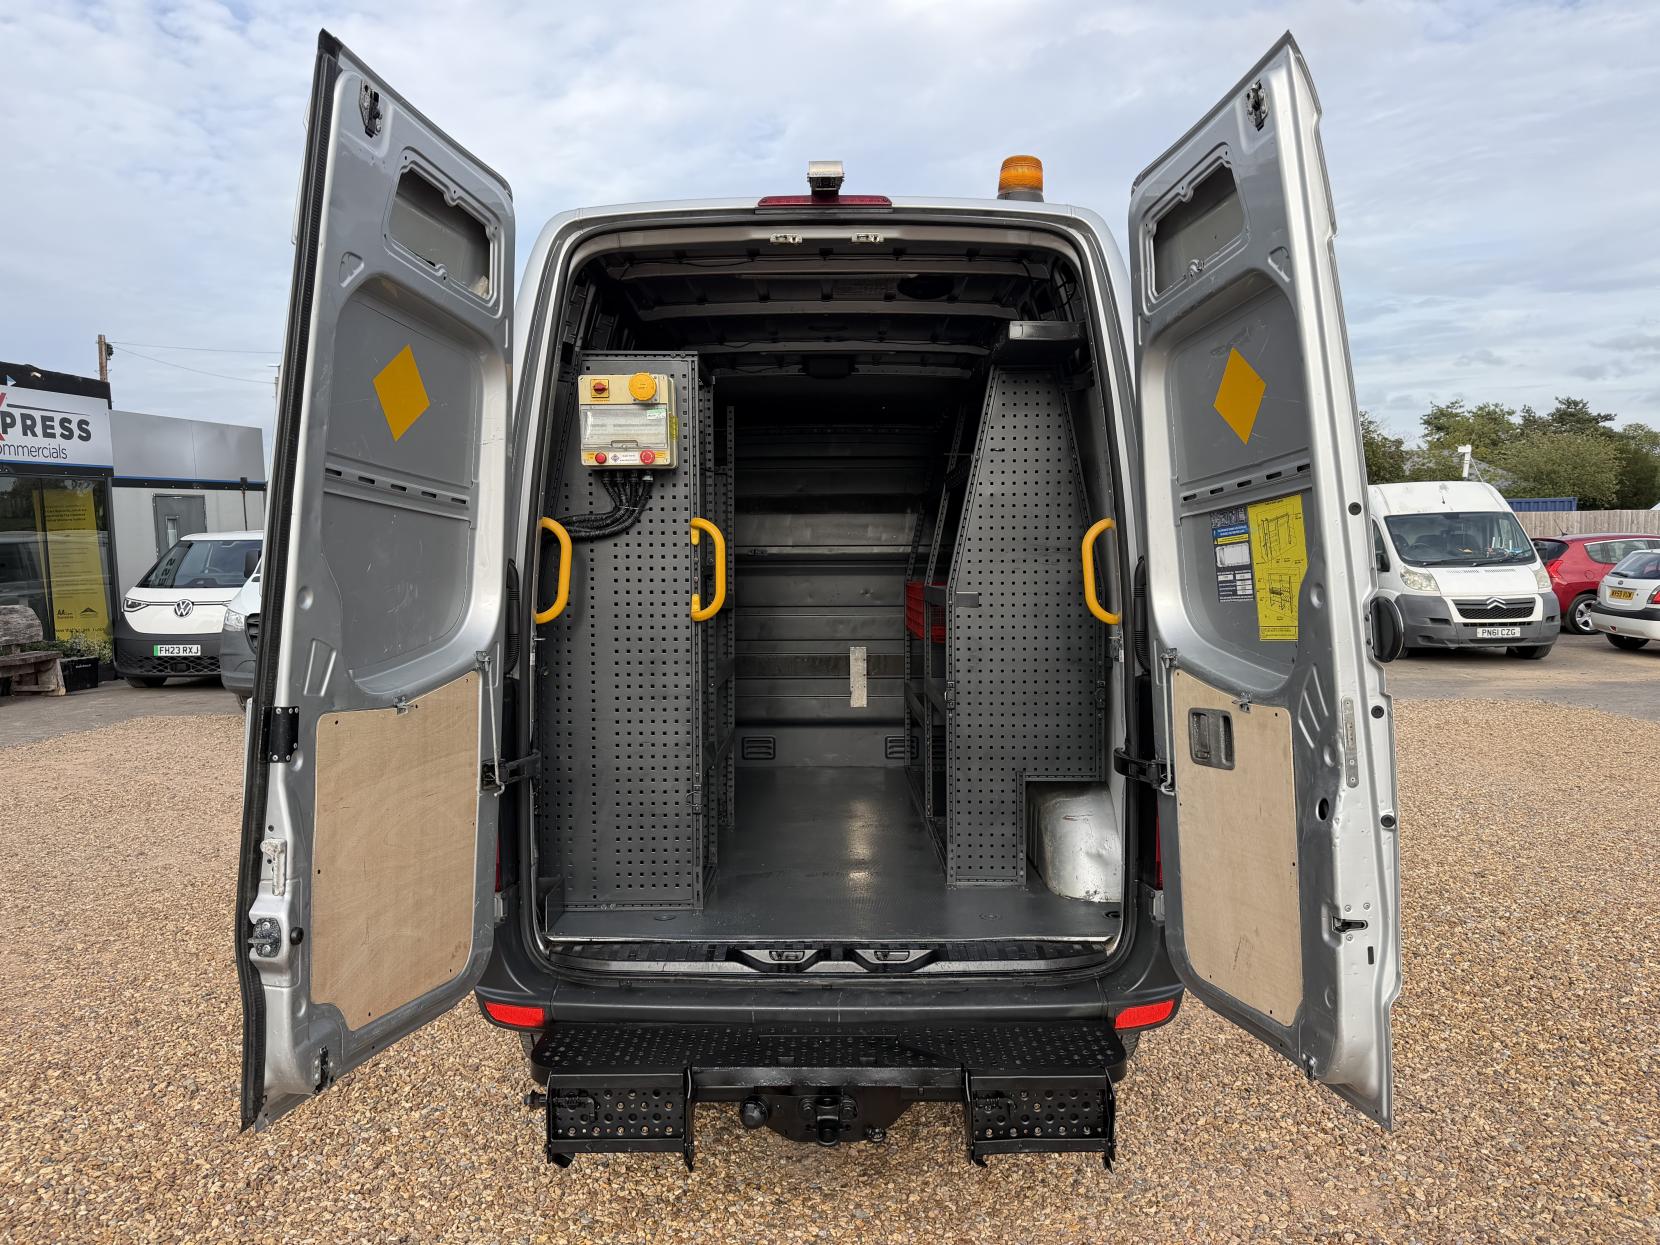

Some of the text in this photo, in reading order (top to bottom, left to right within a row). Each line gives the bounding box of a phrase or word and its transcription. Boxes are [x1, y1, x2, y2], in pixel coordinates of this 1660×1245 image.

[0, 393, 91, 442] PRESS
[0, 443, 68, 459] mmercials
[1500, 628, 1516, 636] CZG
[159, 646, 200, 655] FH23 RXJ
